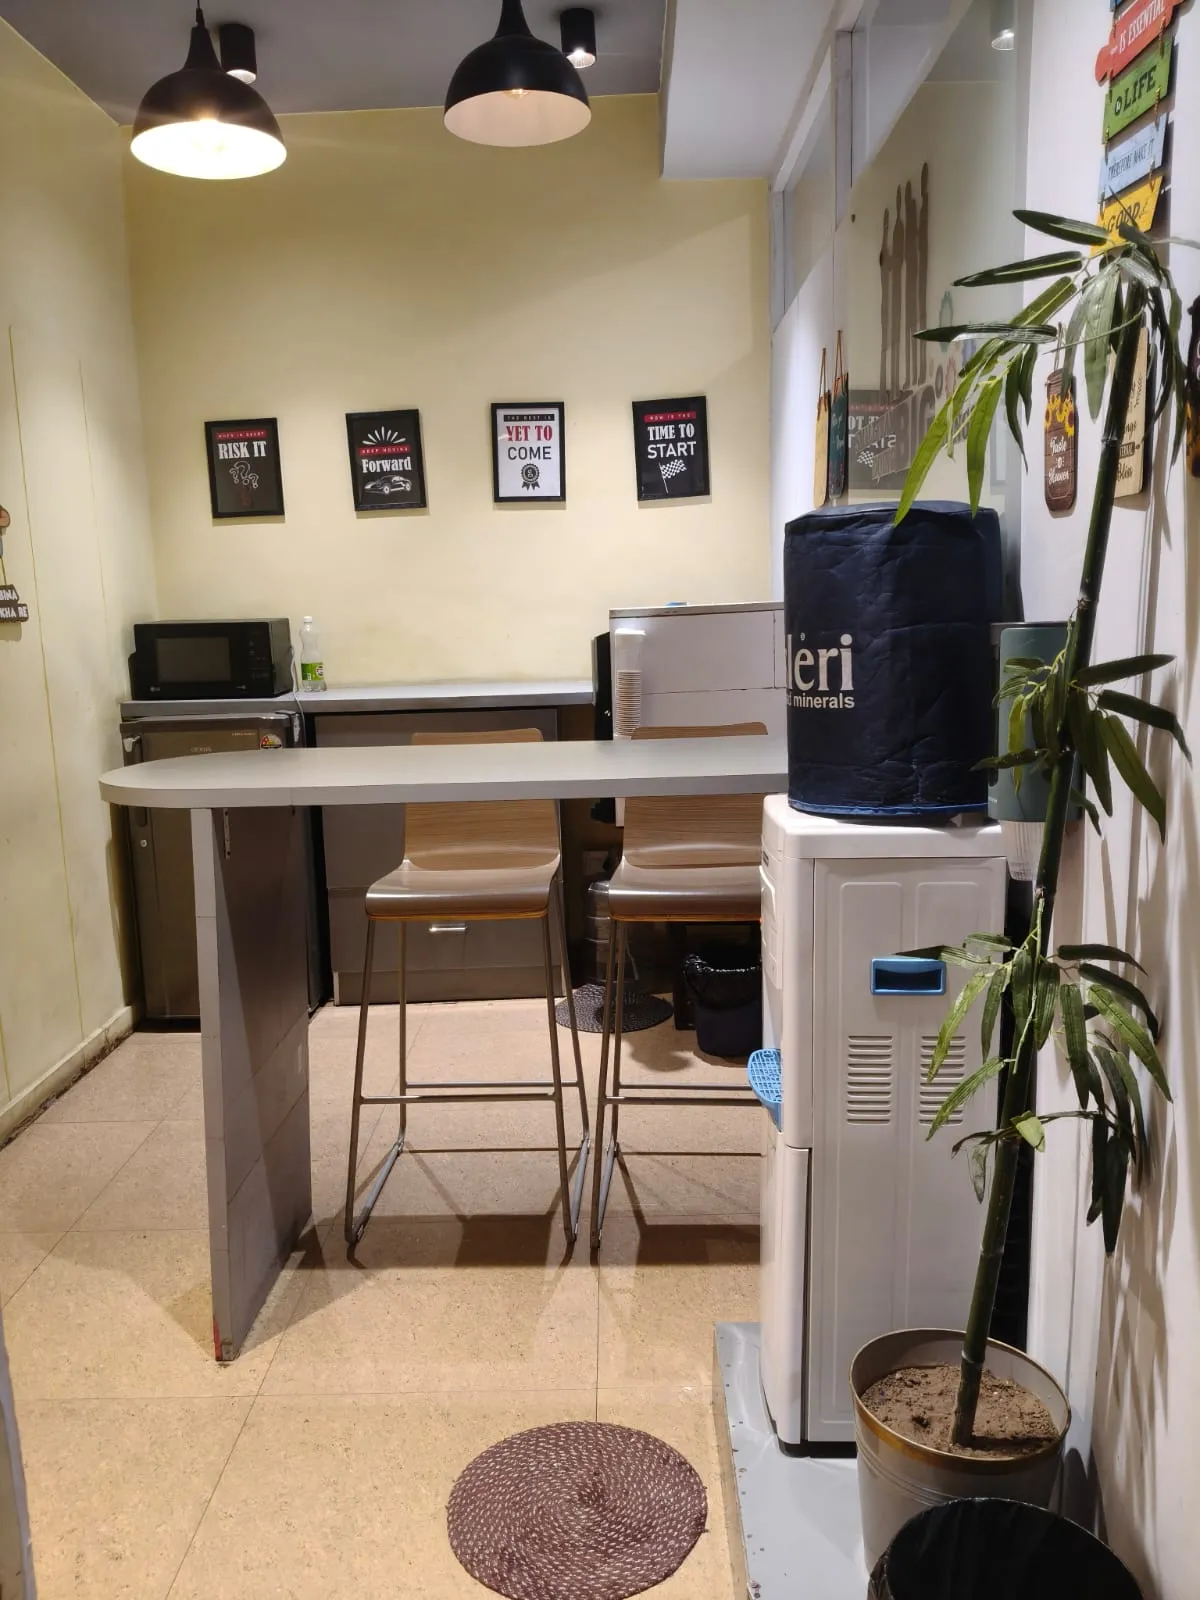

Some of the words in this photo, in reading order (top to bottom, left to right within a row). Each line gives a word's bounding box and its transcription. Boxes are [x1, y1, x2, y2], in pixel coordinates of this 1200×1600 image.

[1123, 65, 1158, 112] LIFE
[506, 425, 530, 441] YET
[535, 425, 552, 441] TO
[648, 425, 675, 441] TIME
[679, 423, 695, 439] TO
[218, 442, 250, 459] RISK
[253, 441, 267, 457] IT
[508, 446, 552, 460] COME
[647, 441, 697, 459] START
[362, 456, 412, 473] Forward
[793, 692, 855, 709] minerals
